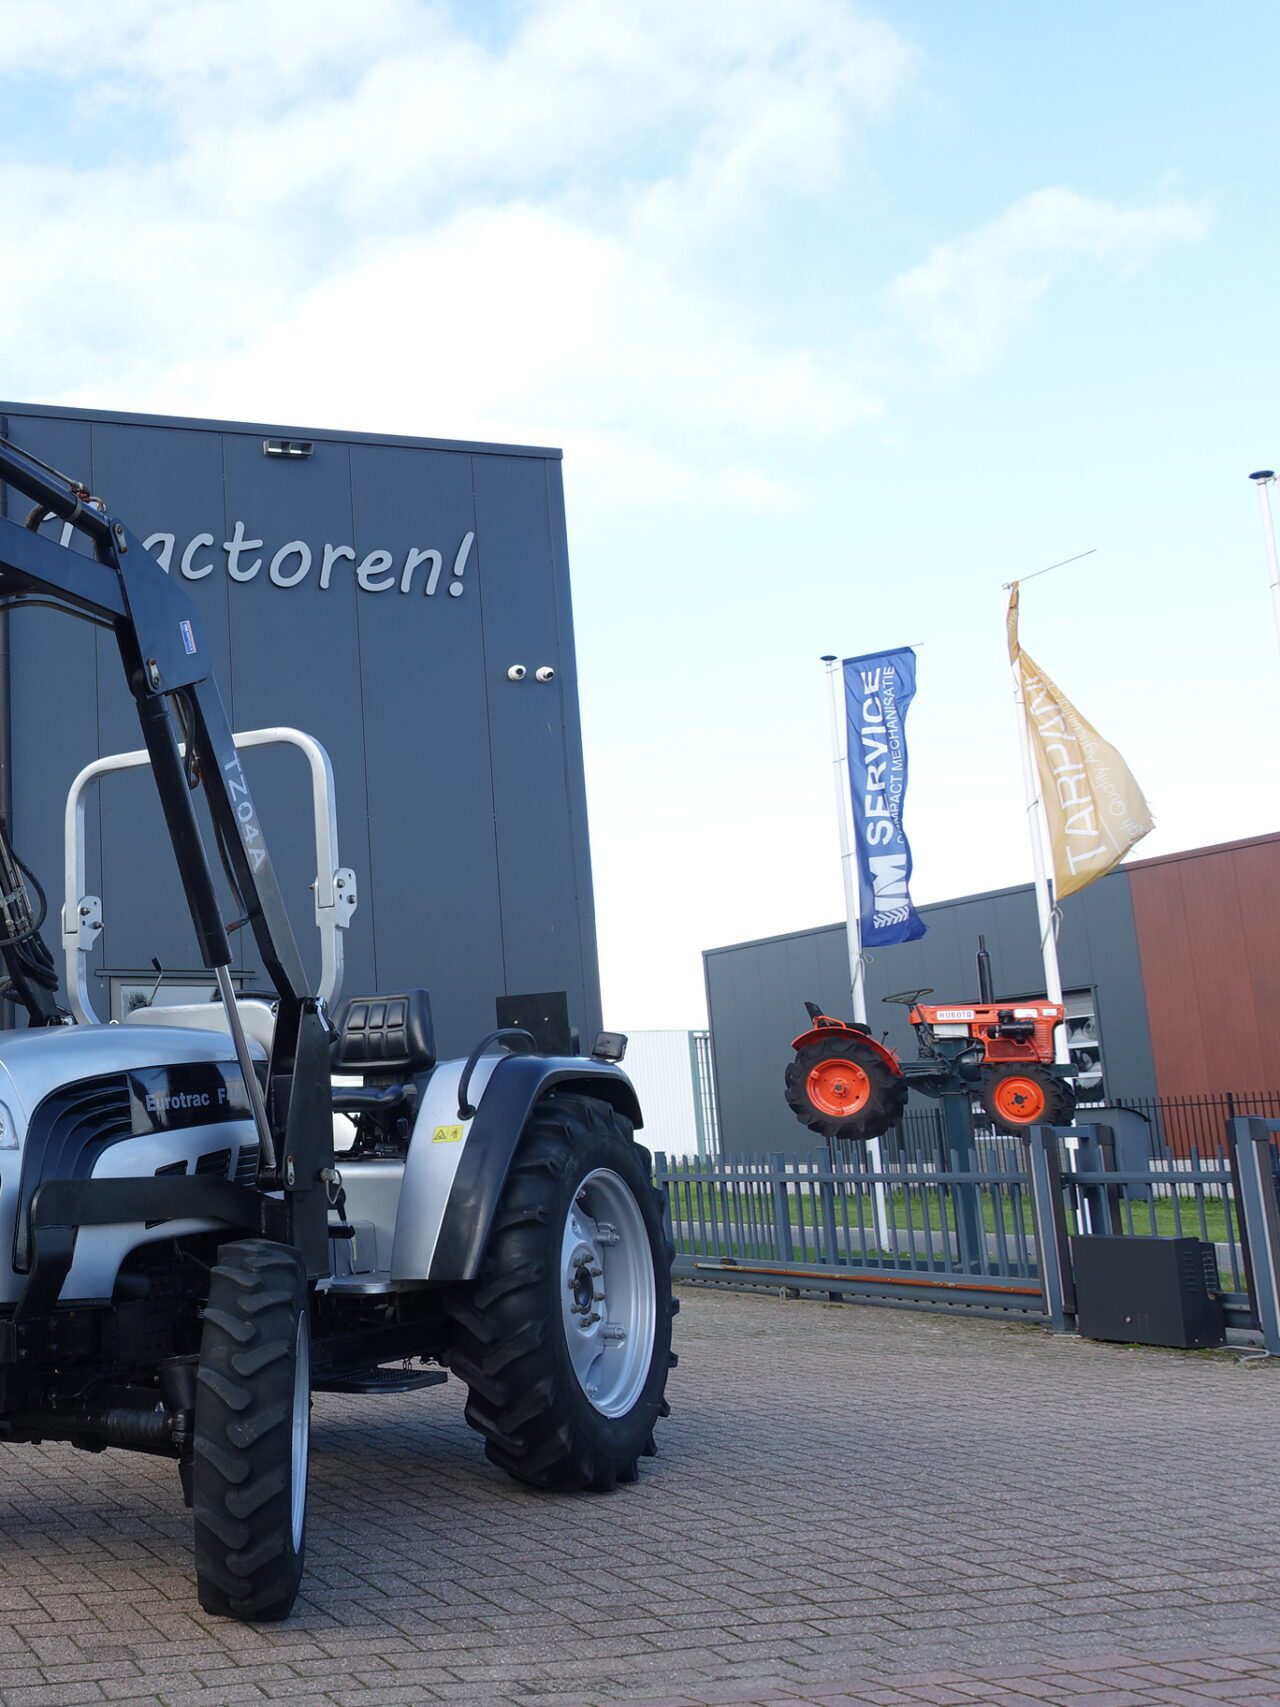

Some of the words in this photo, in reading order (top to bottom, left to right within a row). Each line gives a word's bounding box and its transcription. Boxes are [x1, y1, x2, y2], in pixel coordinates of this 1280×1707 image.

[861, 667, 894, 846] SERVICE
[882, 666, 903, 771] MECHANISATIE
[145, 1092, 210, 1111] Eurotrac
